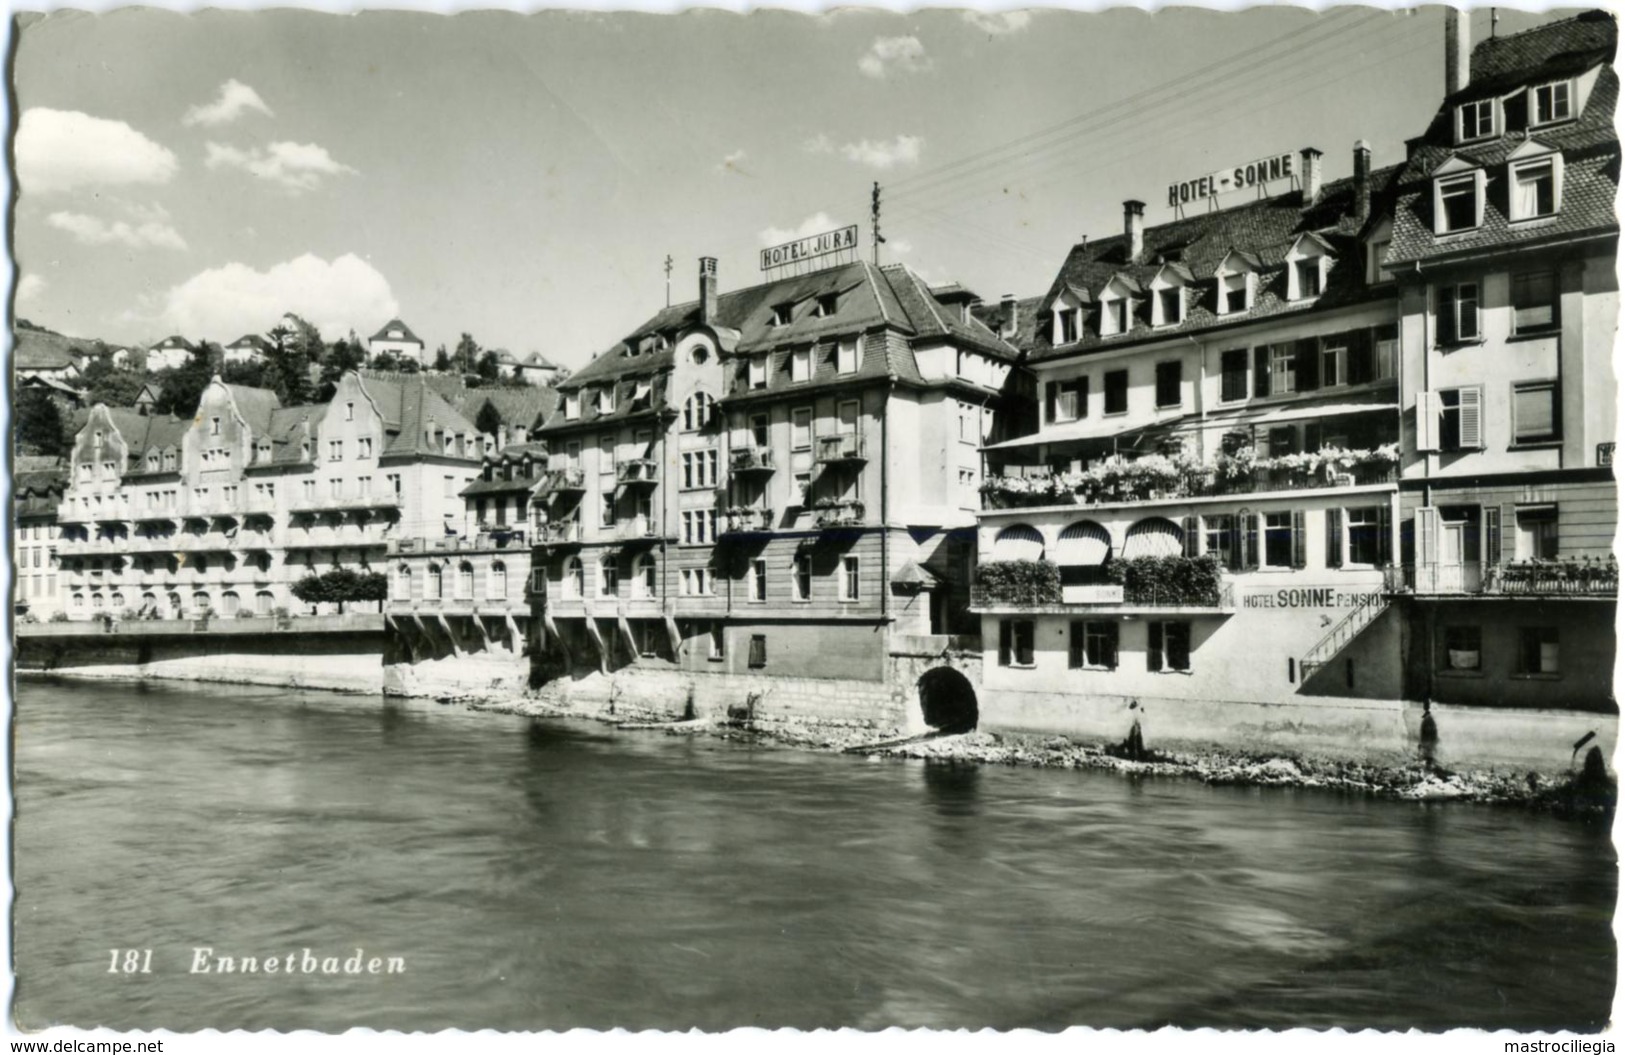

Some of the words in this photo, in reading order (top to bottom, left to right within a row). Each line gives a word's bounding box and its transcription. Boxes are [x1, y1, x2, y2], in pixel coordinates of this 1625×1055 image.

[1168, 175, 1218, 207] HOTEL
[1233, 154, 1292, 188] SONNE
[763, 243, 807, 267] HOTEL
[813, 229, 852, 253] JURA
[1243, 594, 1275, 608] HOTEL
[1277, 588, 1335, 608] SONNE
